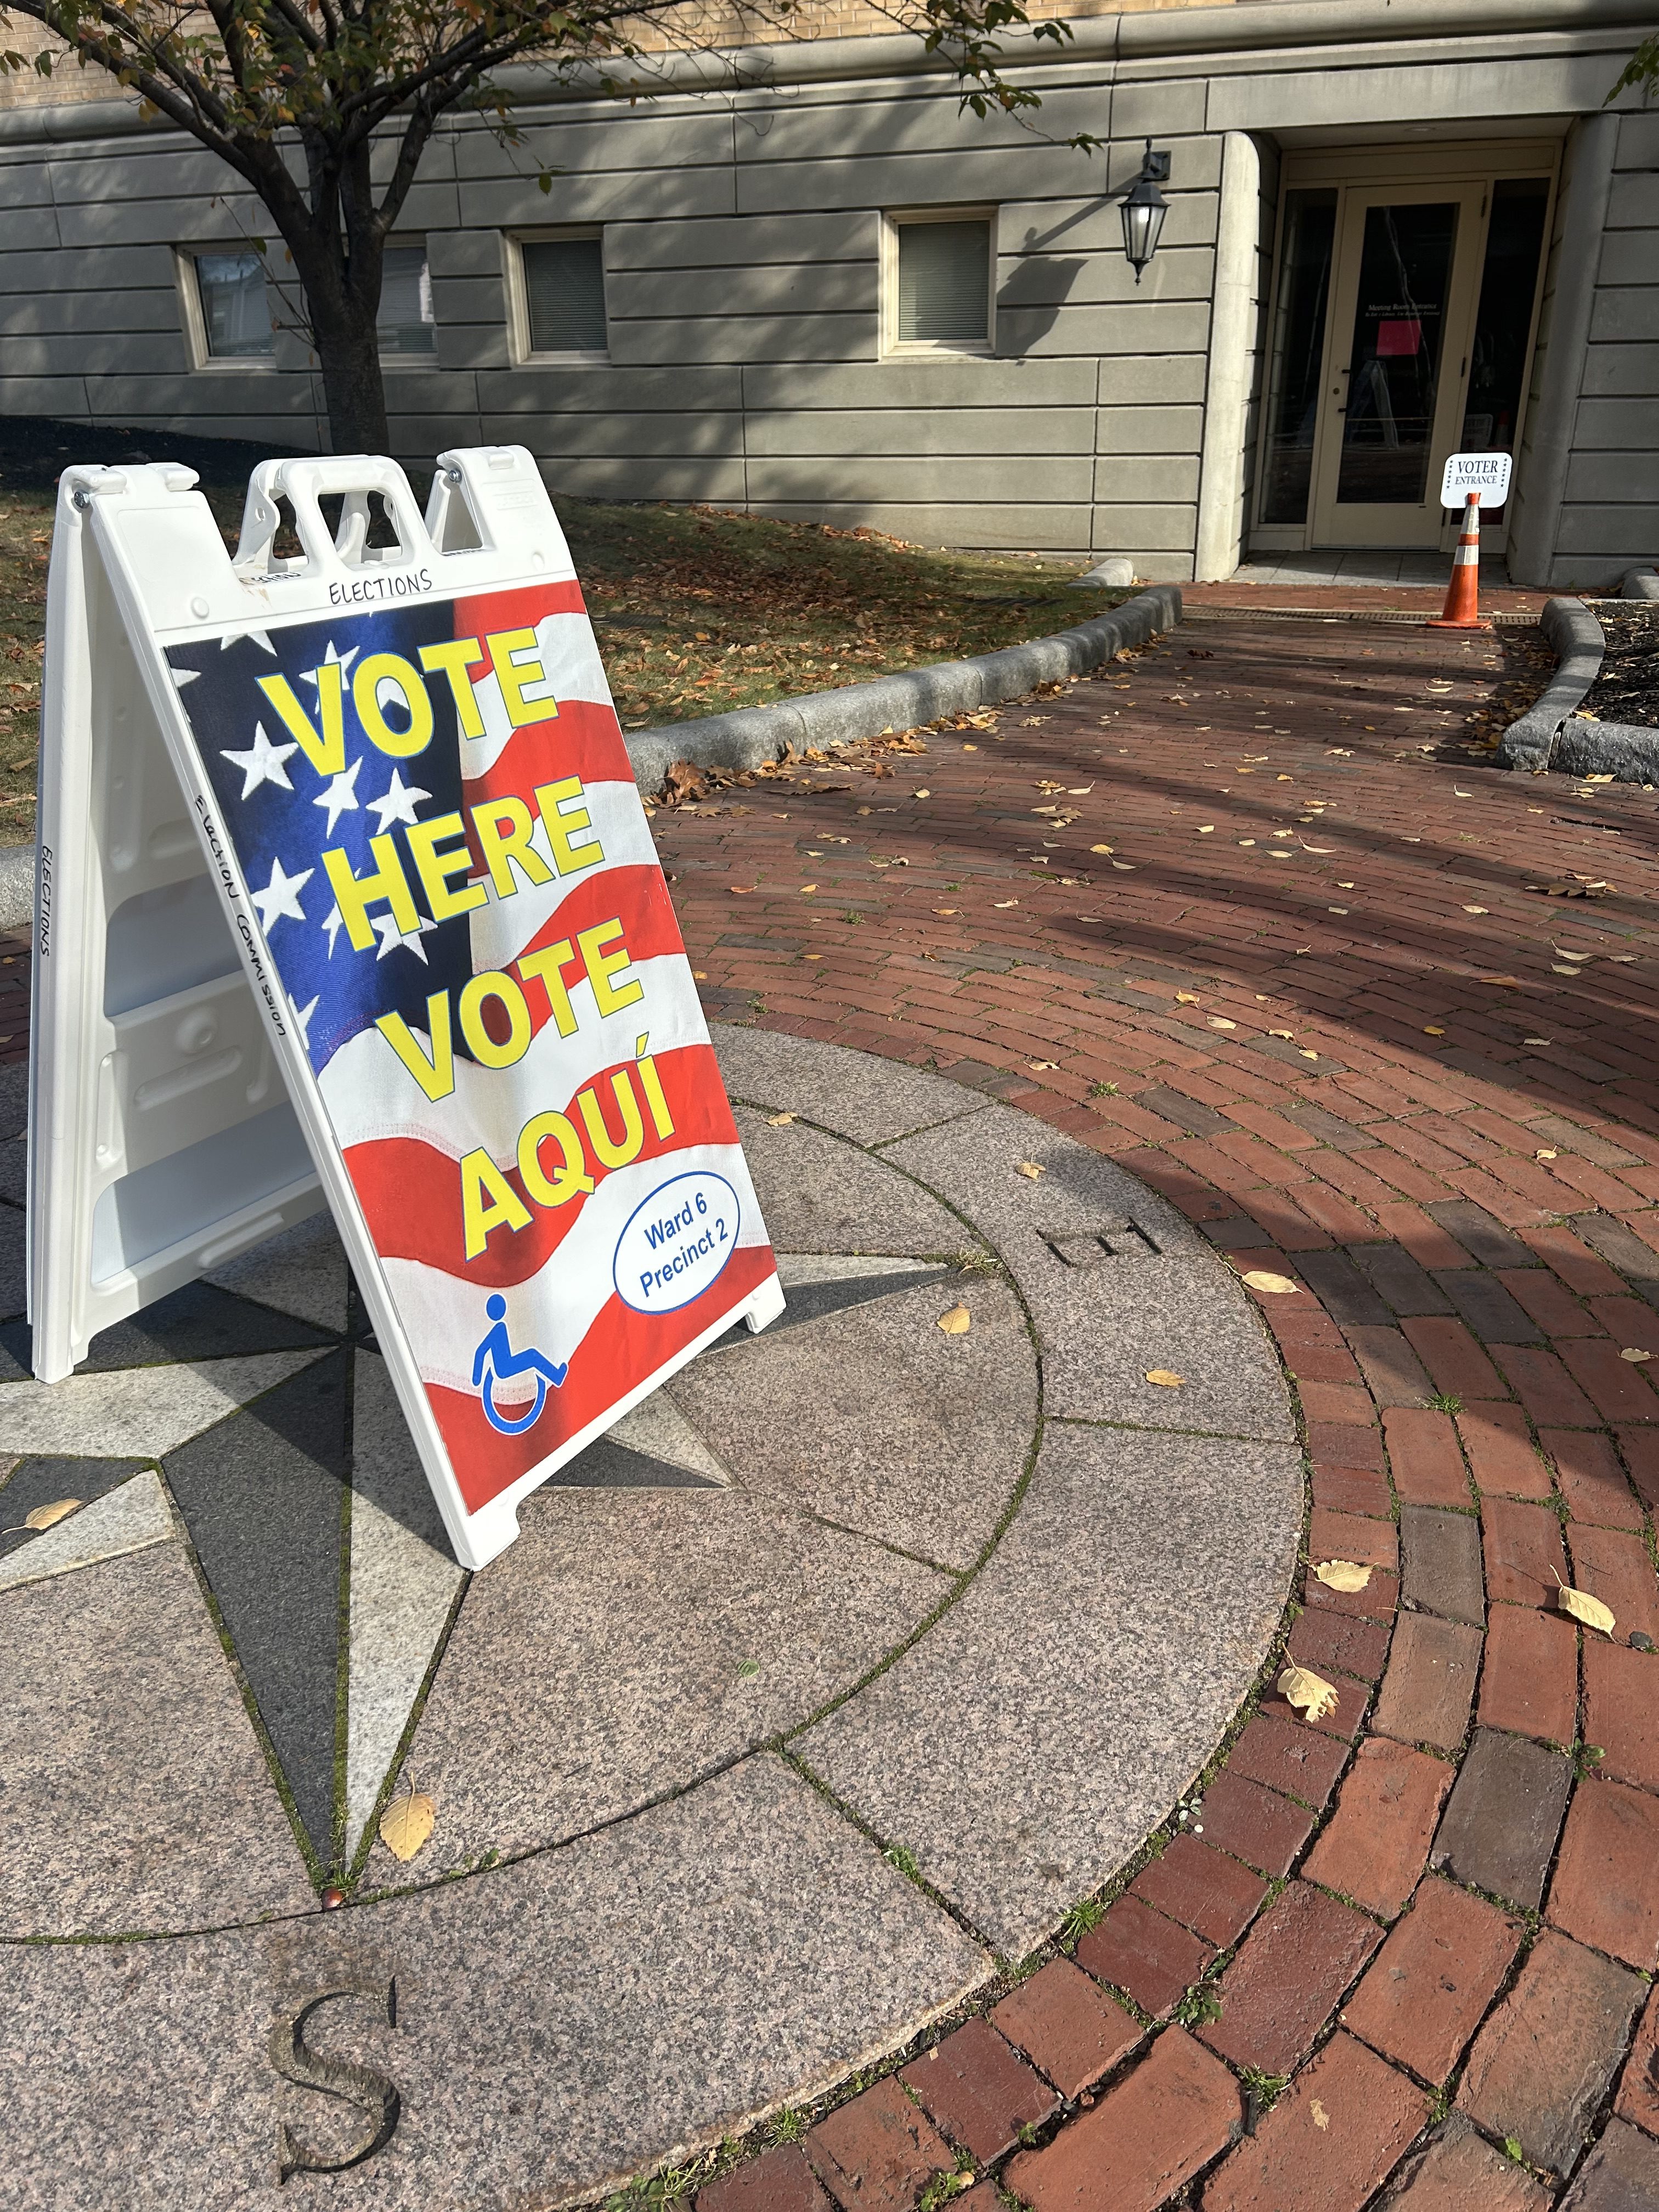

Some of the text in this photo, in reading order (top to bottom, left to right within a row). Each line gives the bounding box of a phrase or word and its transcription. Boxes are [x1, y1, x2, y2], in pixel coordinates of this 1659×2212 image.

[1455, 475, 1498, 485] ENTRANCE
[1458, 460, 1498, 474] VOTER
[329, 568, 432, 605] ELECTIONS
[255, 626, 560, 776] VOTE
[41, 845, 53, 957] ELECTIONS
[321, 774, 605, 952] HERE
[375, 916, 644, 1102] VOTE
[460, 1031, 675, 1262] AQUÍ
[640, 1217, 729, 1297] Precinct 2
[644, 1192, 707, 1250] Ward 6
[269, 1976, 401, 2186] S
